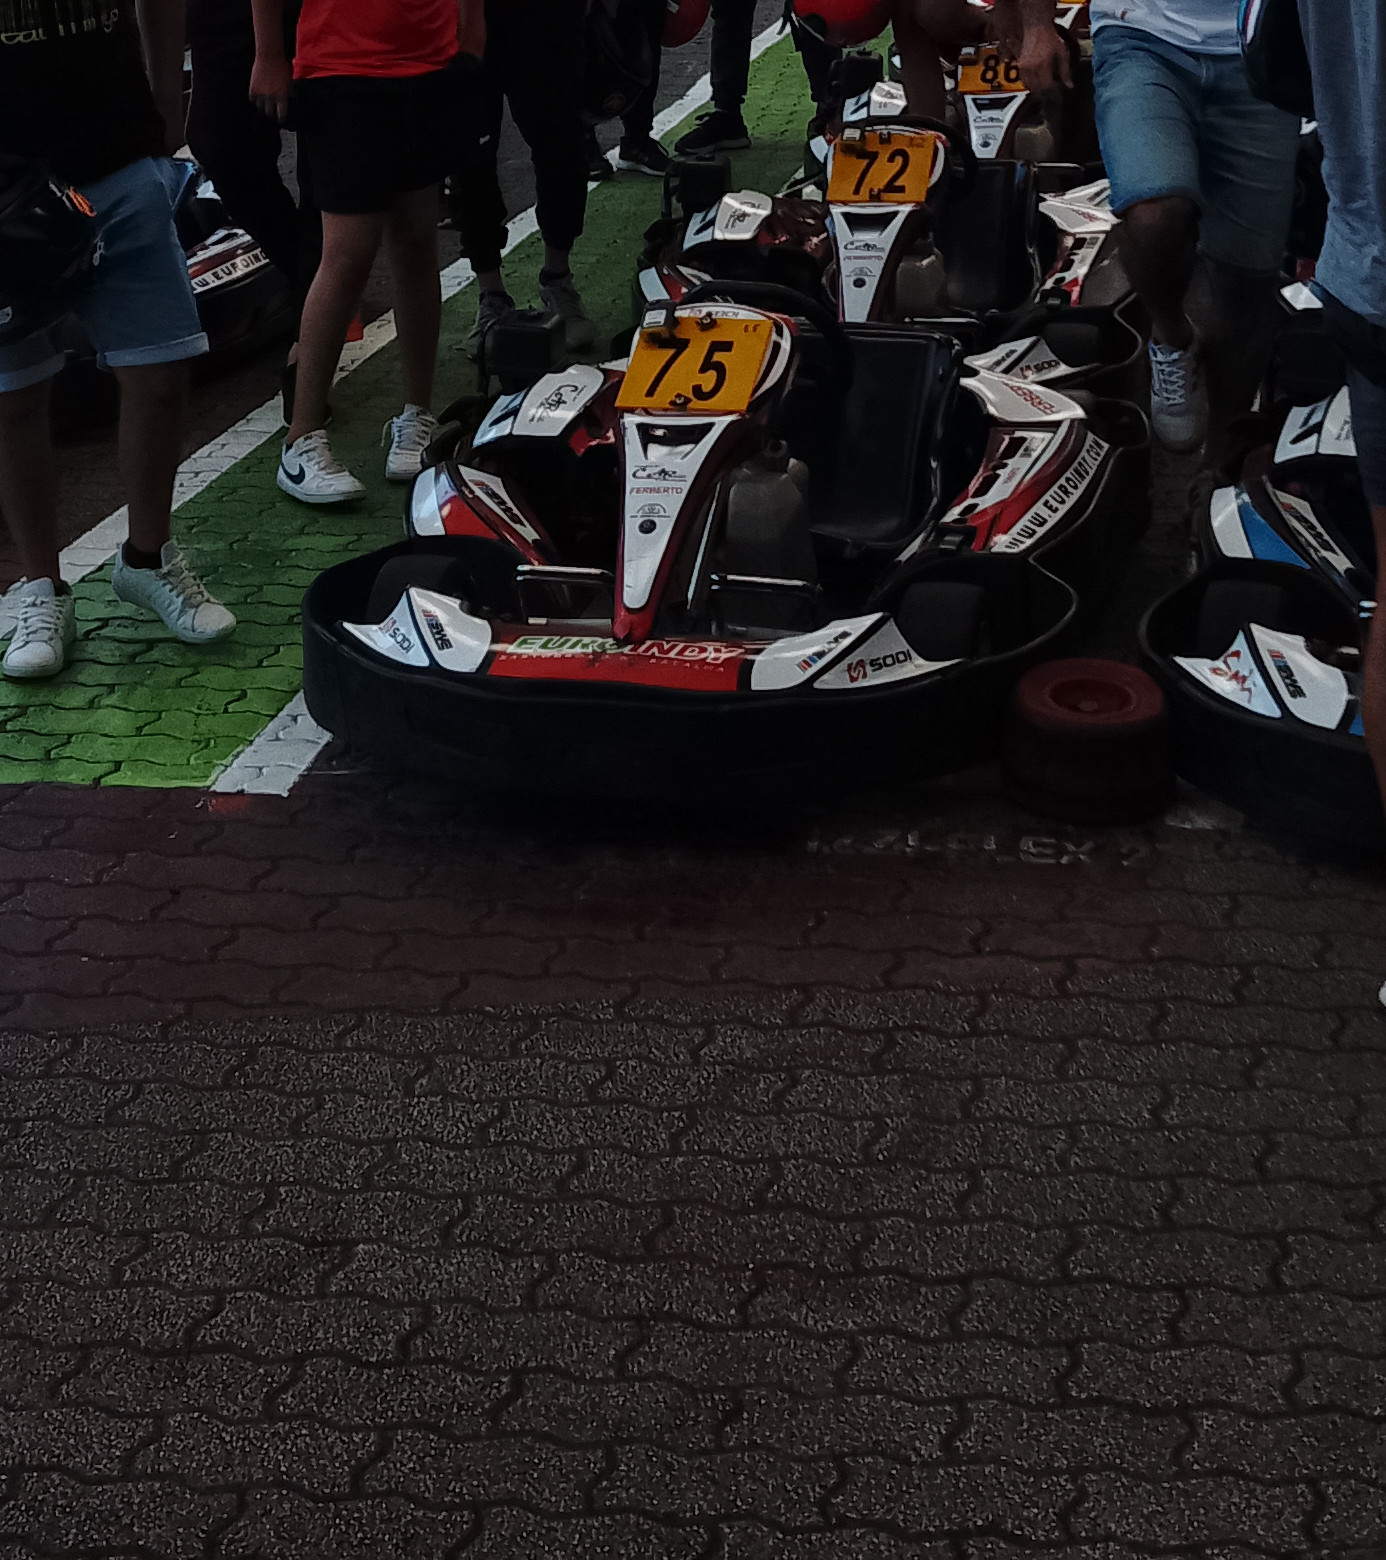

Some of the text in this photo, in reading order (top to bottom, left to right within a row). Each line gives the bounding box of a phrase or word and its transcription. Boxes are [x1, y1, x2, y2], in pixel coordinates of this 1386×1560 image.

[979, 53, 1021, 84] 86
[851, 147, 910, 197] 72
[645, 336, 735, 402] 75
[868, 648, 913, 673] SODI
